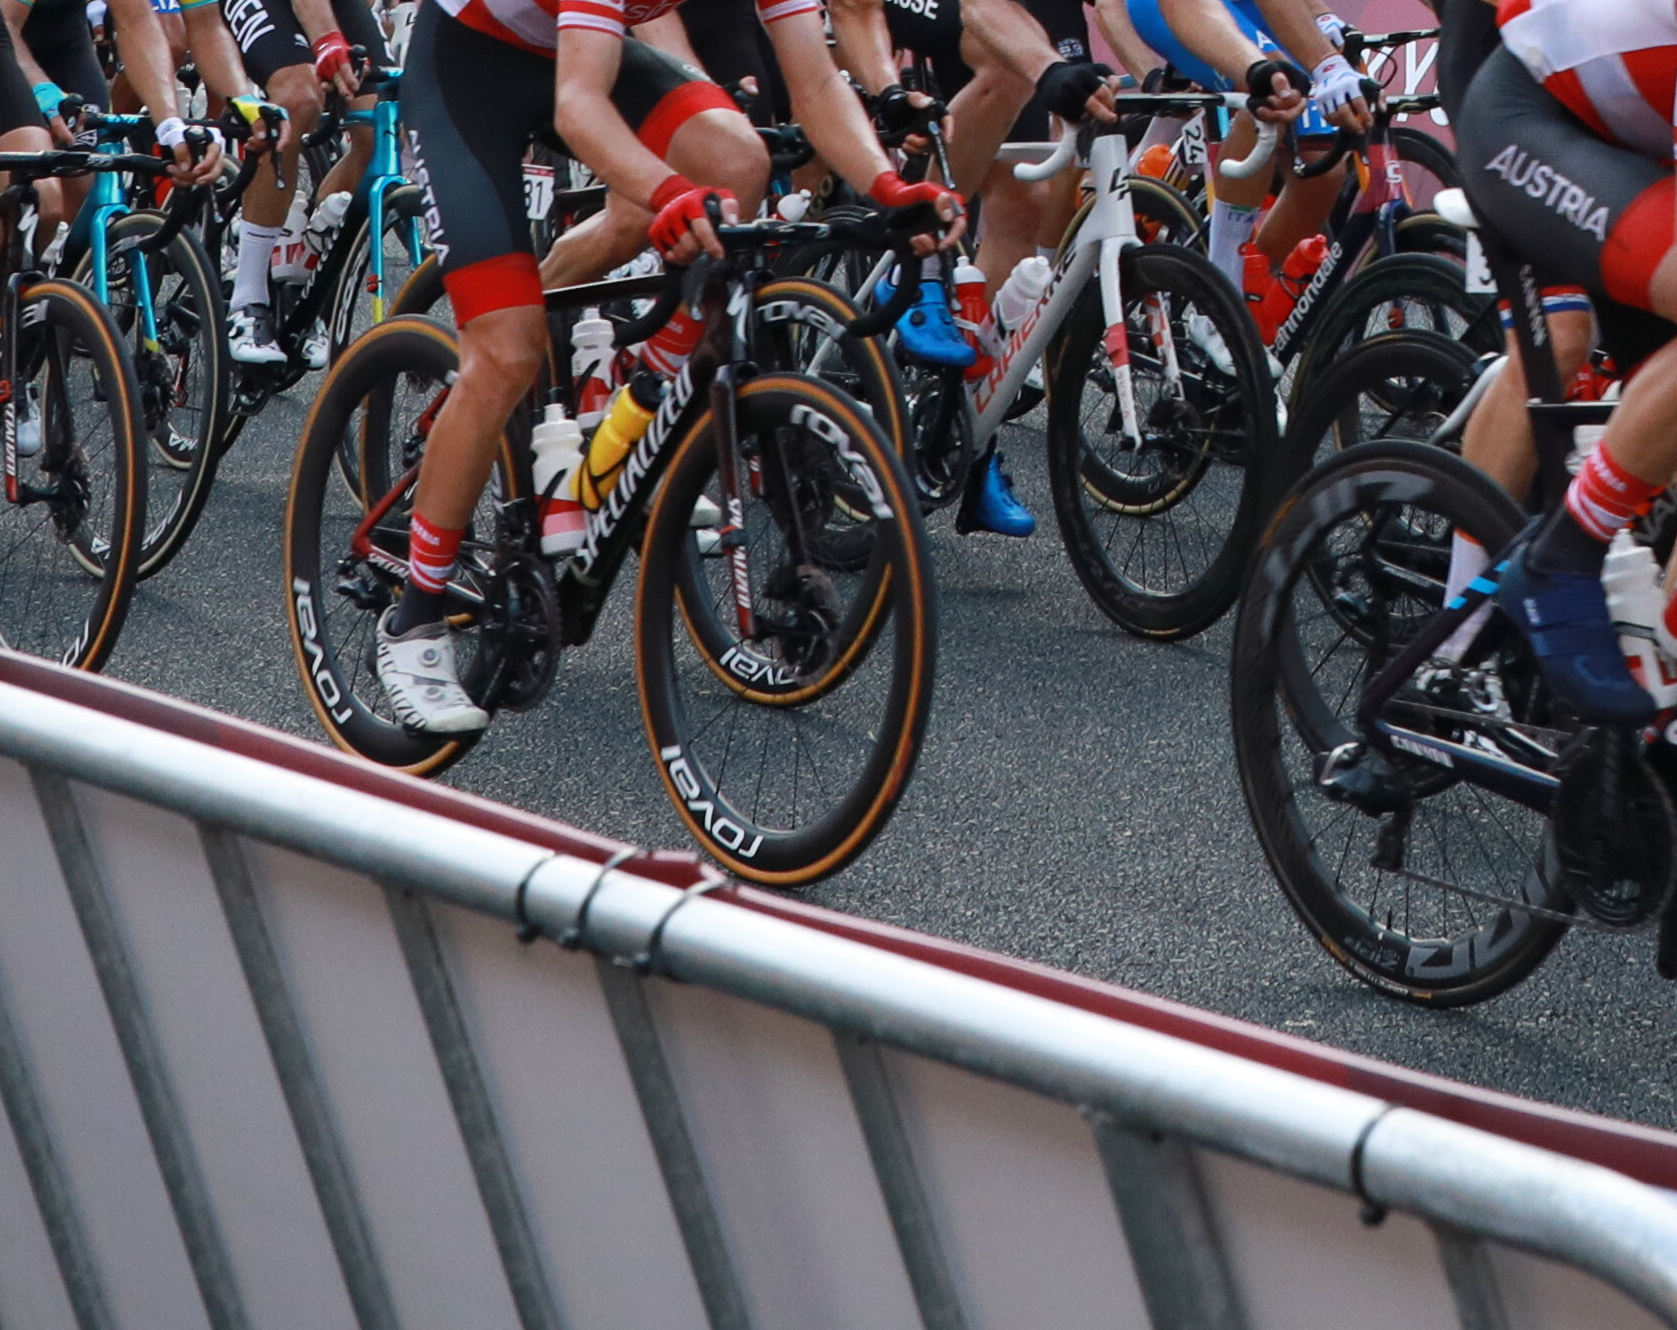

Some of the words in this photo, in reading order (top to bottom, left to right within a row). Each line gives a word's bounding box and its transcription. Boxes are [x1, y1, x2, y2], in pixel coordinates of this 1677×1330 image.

[1484, 144, 1611, 241] AUSTRIA
[292, 577, 352, 728] roval
[661, 745, 763, 859] roval
